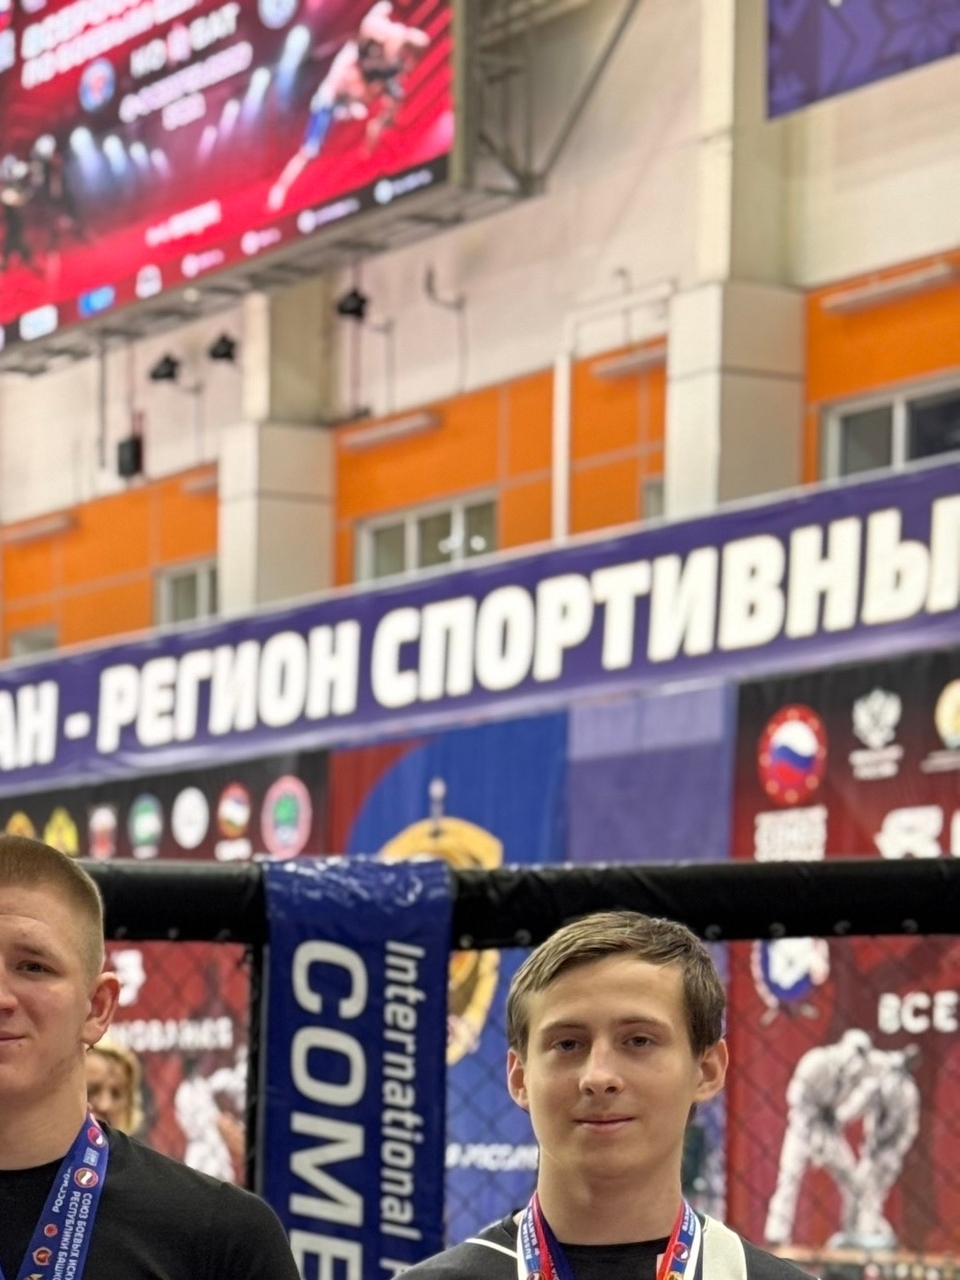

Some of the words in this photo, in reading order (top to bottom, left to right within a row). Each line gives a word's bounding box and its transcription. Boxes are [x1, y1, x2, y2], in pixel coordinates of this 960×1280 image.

[97, 619, 361, 756] РЕГИОН
[370, 493, 960, 709] СПОРТИВНЫ
[380, 940, 426, 1241] International
[61, 1190, 81, 1251] РЕСПУБЛИКИ
[79, 1193, 93, 1216] СОЮЗ
[72, 1216, 87, 1256] БОЕВЫХ
